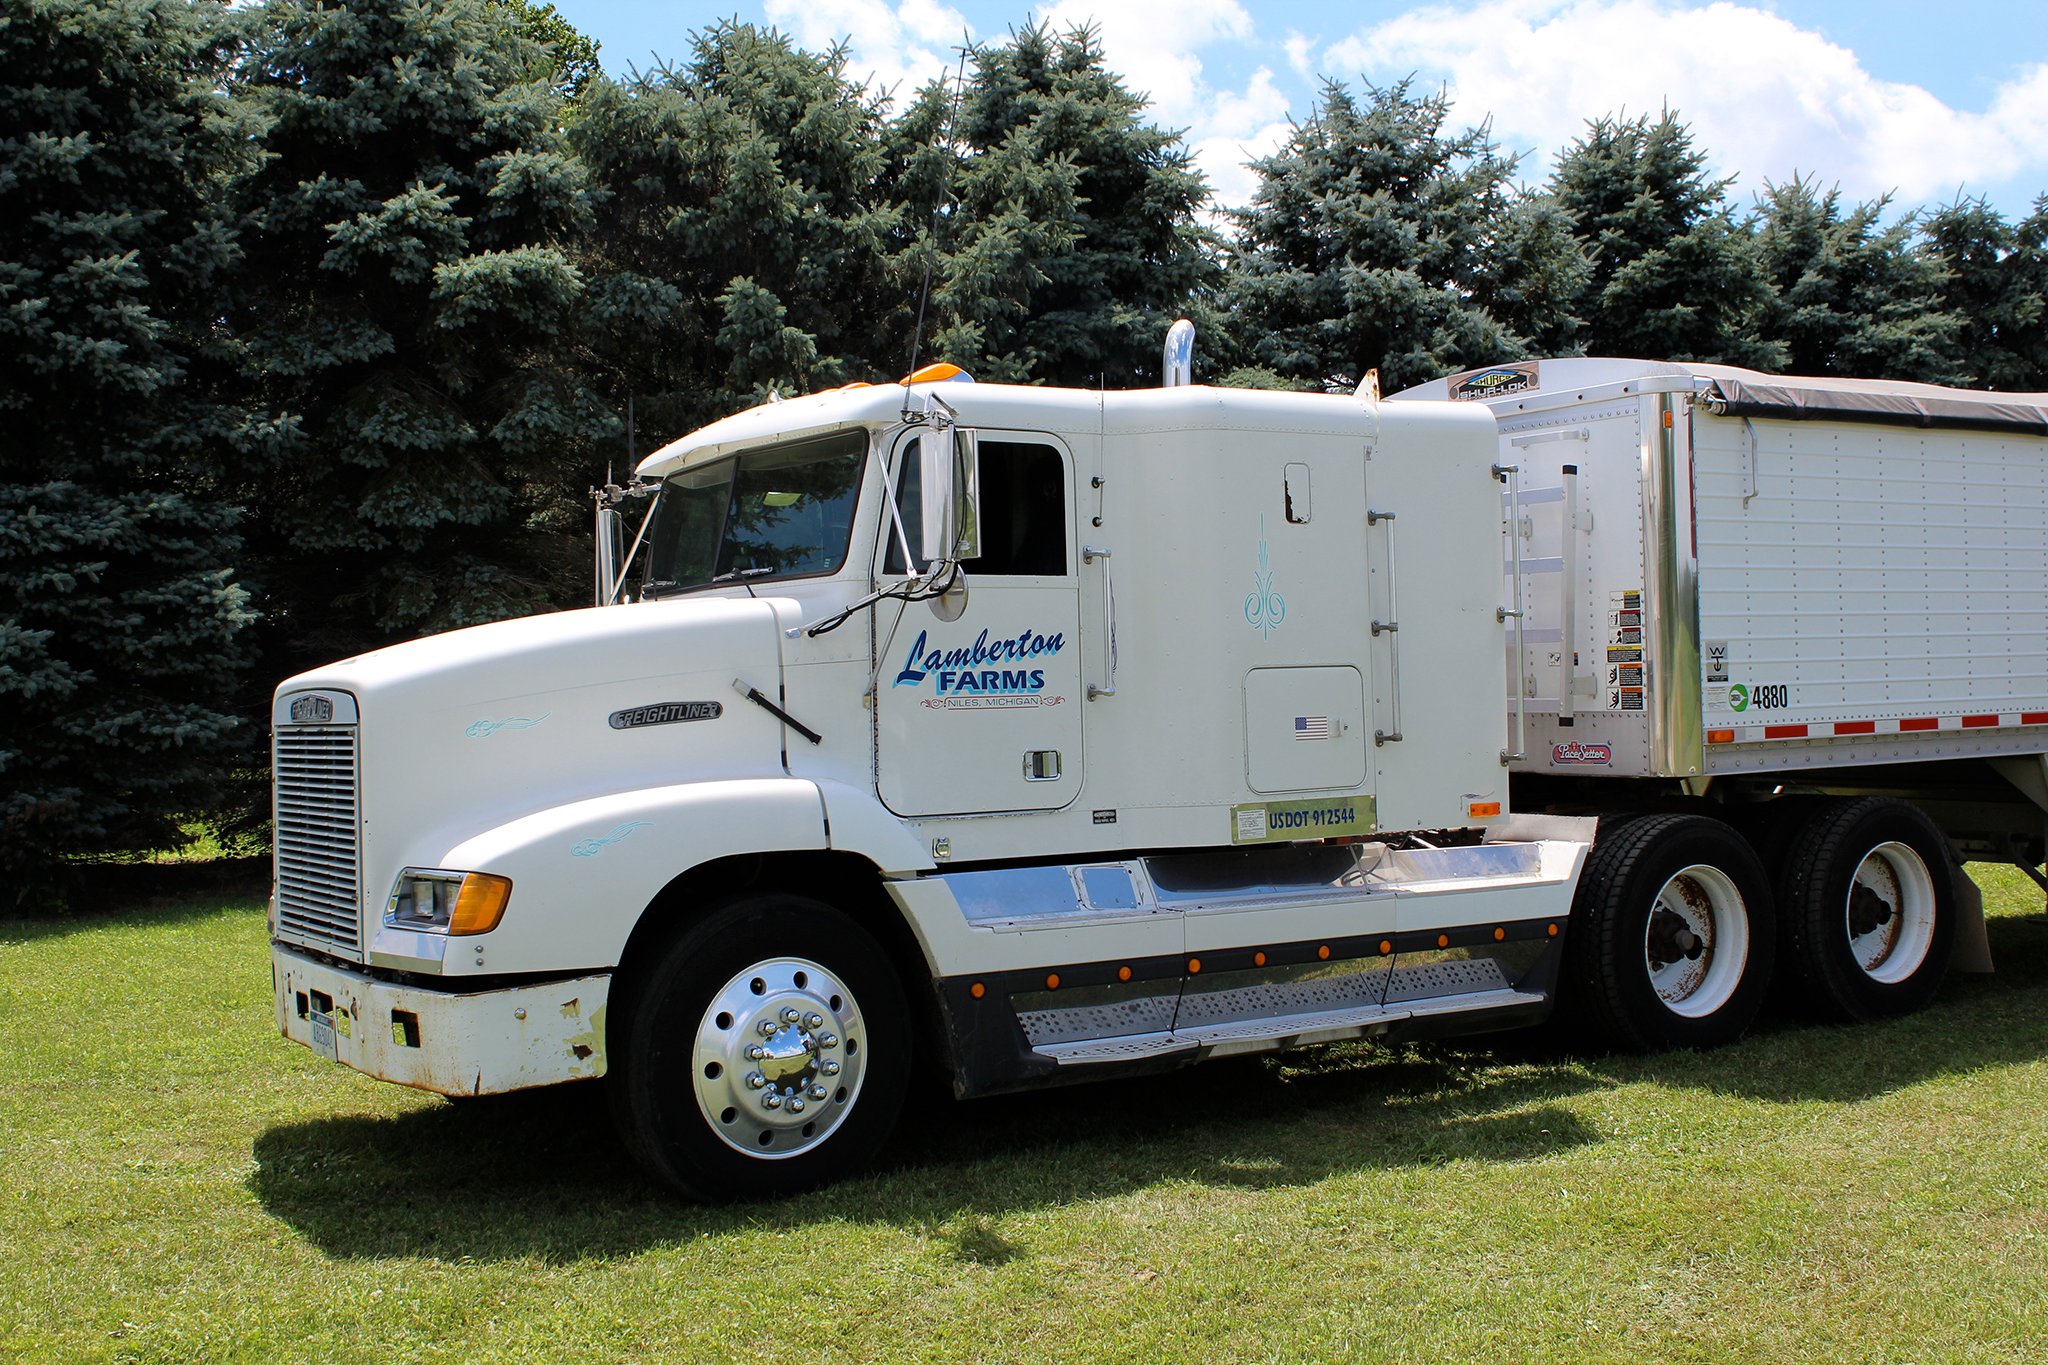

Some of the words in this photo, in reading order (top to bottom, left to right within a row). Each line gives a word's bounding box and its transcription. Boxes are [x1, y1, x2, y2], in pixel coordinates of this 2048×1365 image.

[1460, 381, 1527, 399] SHUR-LOK
[893, 628, 1065, 688] Lamberton
[936, 670, 1045, 695] FARMS
[948, 699, 981, 707] NILES,
[986, 698, 1039, 706] MICHIGAN
[1752, 685, 1788, 709] 4880
[616, 703, 718, 727] FREIGHTLINER
[1269, 811, 1309, 829] USDOT
[1312, 808, 1355, 826] 912544
